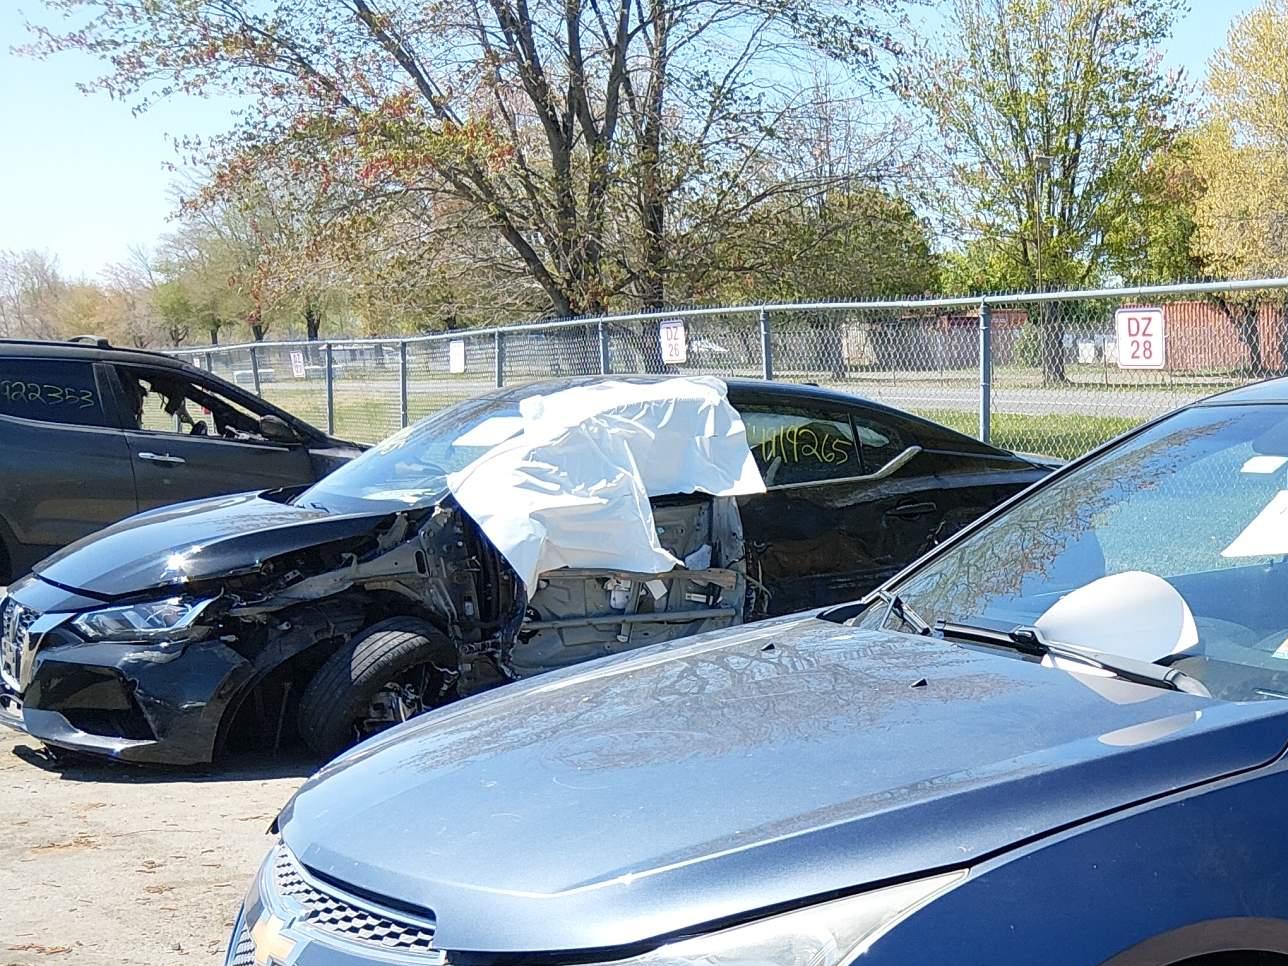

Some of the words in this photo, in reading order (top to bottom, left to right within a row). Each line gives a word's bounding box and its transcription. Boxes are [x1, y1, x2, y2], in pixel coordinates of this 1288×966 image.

[666, 326, 679, 341] DZ
[1127, 316, 1153, 337] DZ
[668, 343, 680, 357] 26
[1130, 339, 1153, 359] 28
